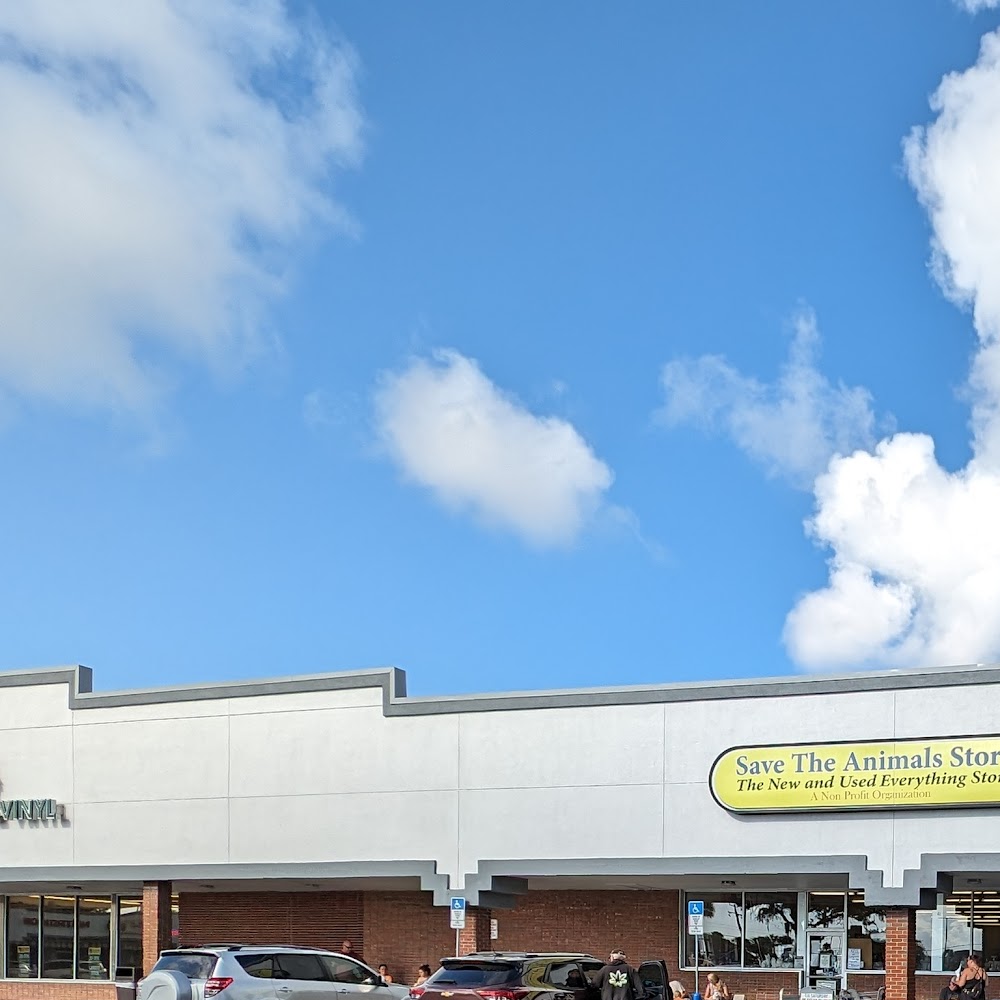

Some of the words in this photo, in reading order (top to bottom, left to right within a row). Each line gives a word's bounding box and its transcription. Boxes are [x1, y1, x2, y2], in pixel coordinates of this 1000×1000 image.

[736, 755, 785, 776] Save
[791, 752, 836, 773] The
[843, 747, 943, 771] Animals
[737, 779, 764, 792] The
[767, 778, 801, 791] New
[804, 776, 835, 789] and
[840, 775, 877, 788] Used
[879, 772, 967, 790] Everything
[810, 792, 818, 801] A
[821, 791, 841, 801] Non
[844, 790, 869, 800] Profit
[872, 789, 931, 800] Organization
[0, 799, 56, 820] VINYL
